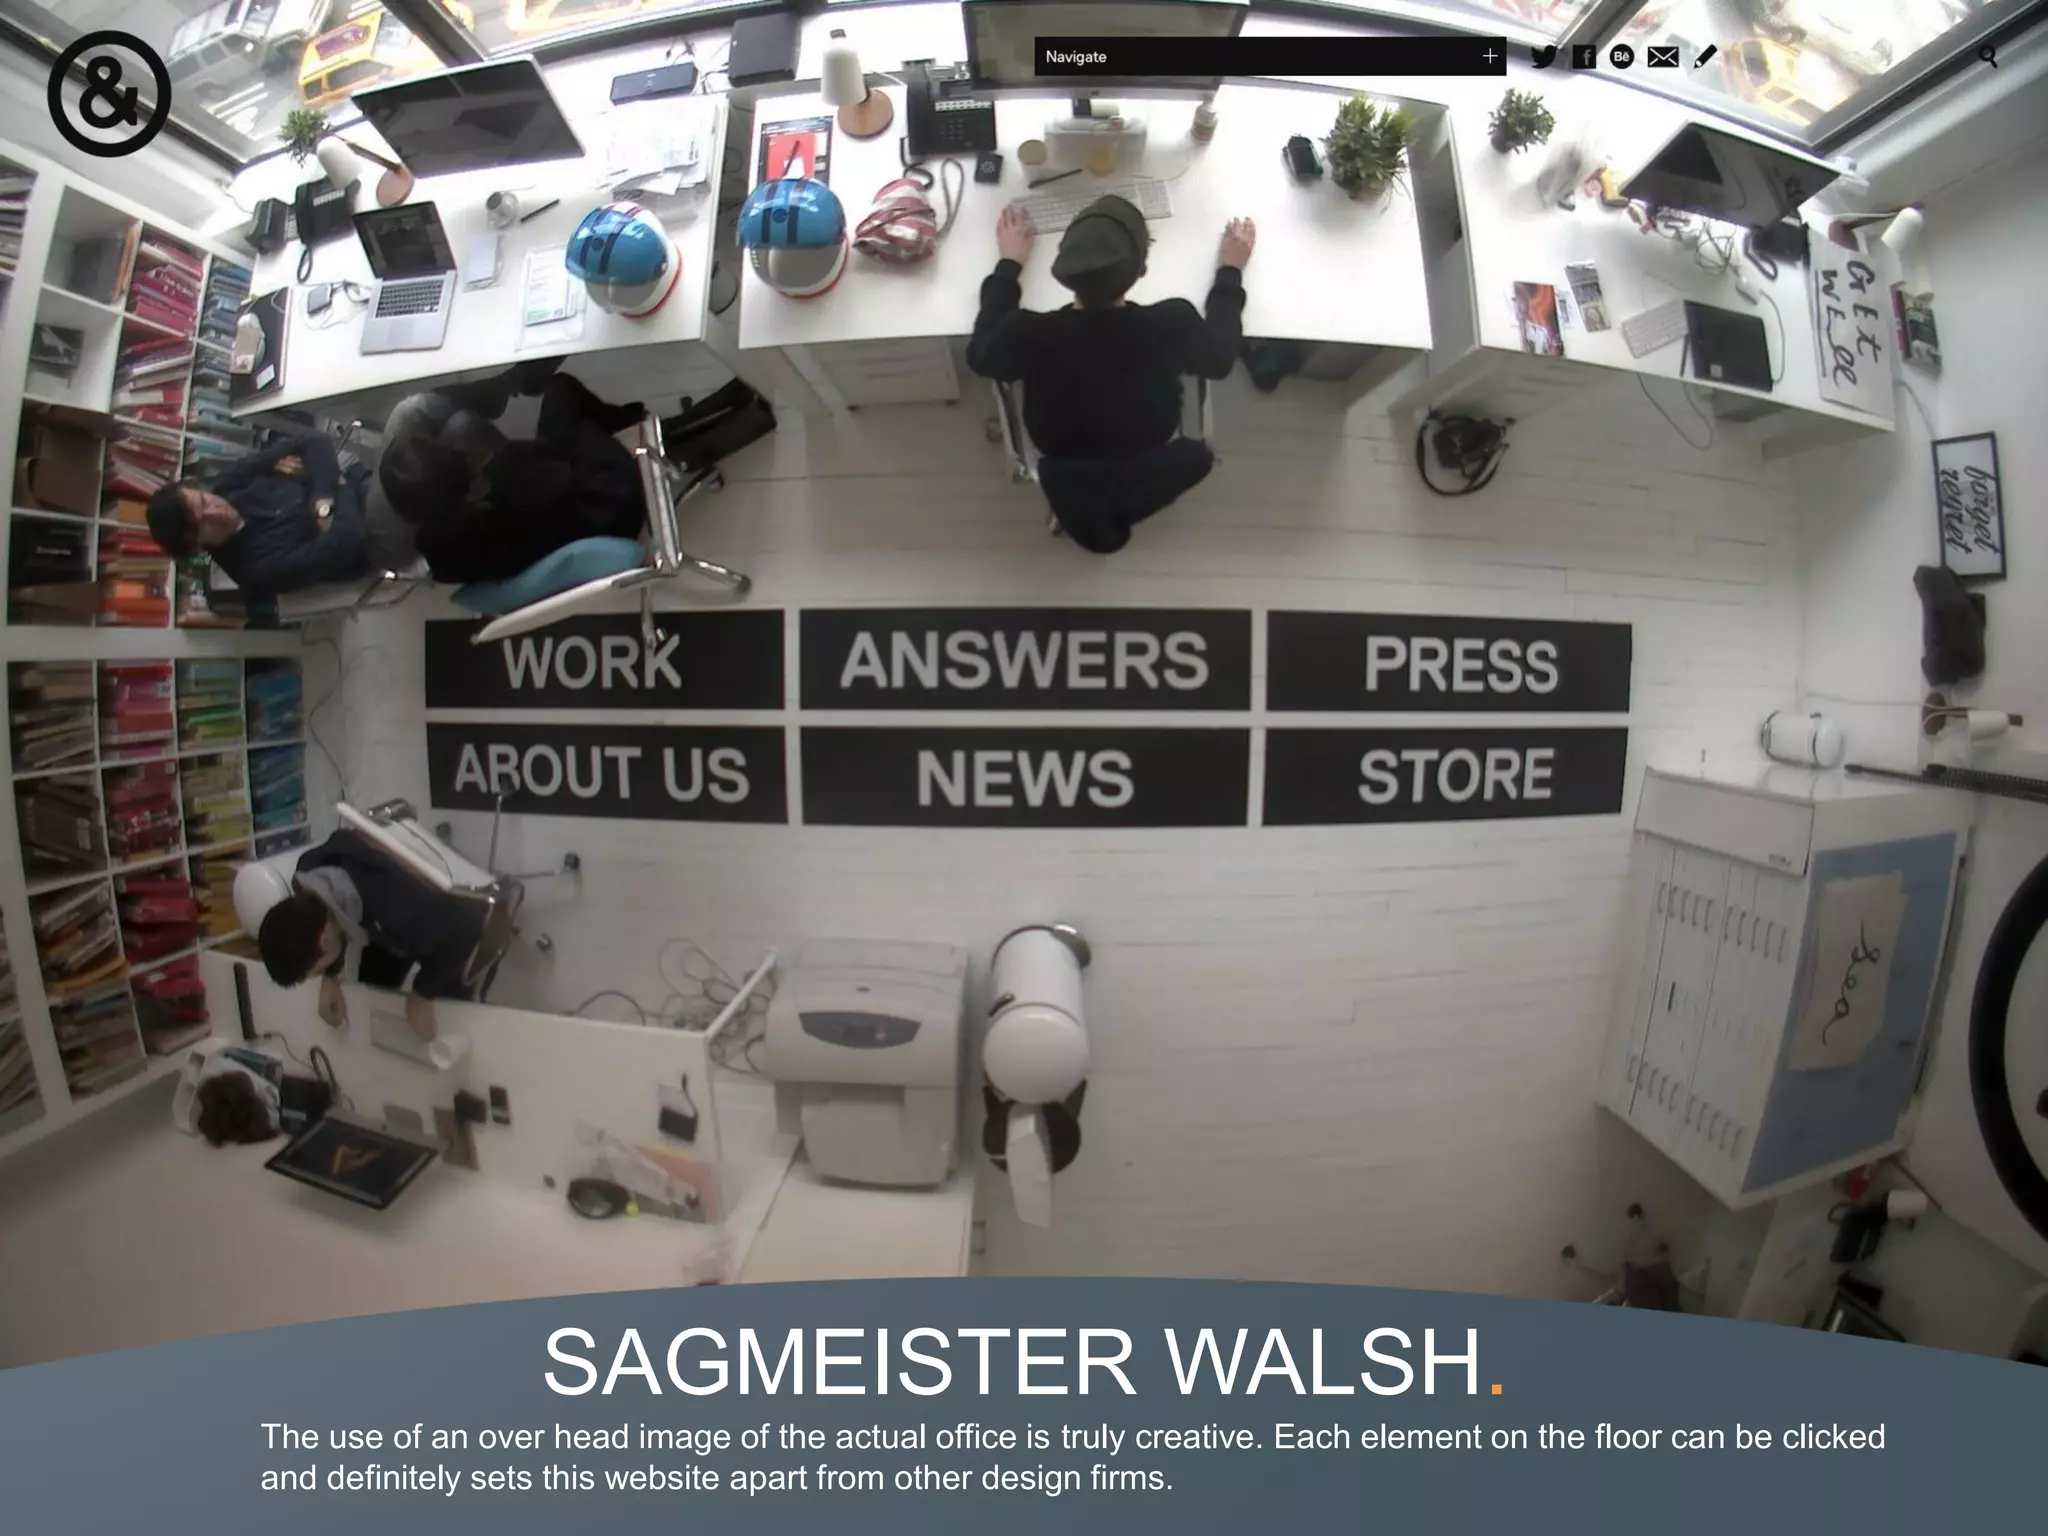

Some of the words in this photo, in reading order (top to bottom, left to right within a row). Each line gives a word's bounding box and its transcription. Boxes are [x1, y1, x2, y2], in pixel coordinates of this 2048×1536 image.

[502, 634, 682, 690] WORK
[840, 631, 1209, 689] ANSWERS
[1366, 635, 1559, 694] PRESS
[455, 743, 642, 799] ABOUT
[663, 747, 750, 803] US
[918, 750, 1134, 808] NEWS
[1358, 748, 1555, 804] STORE
